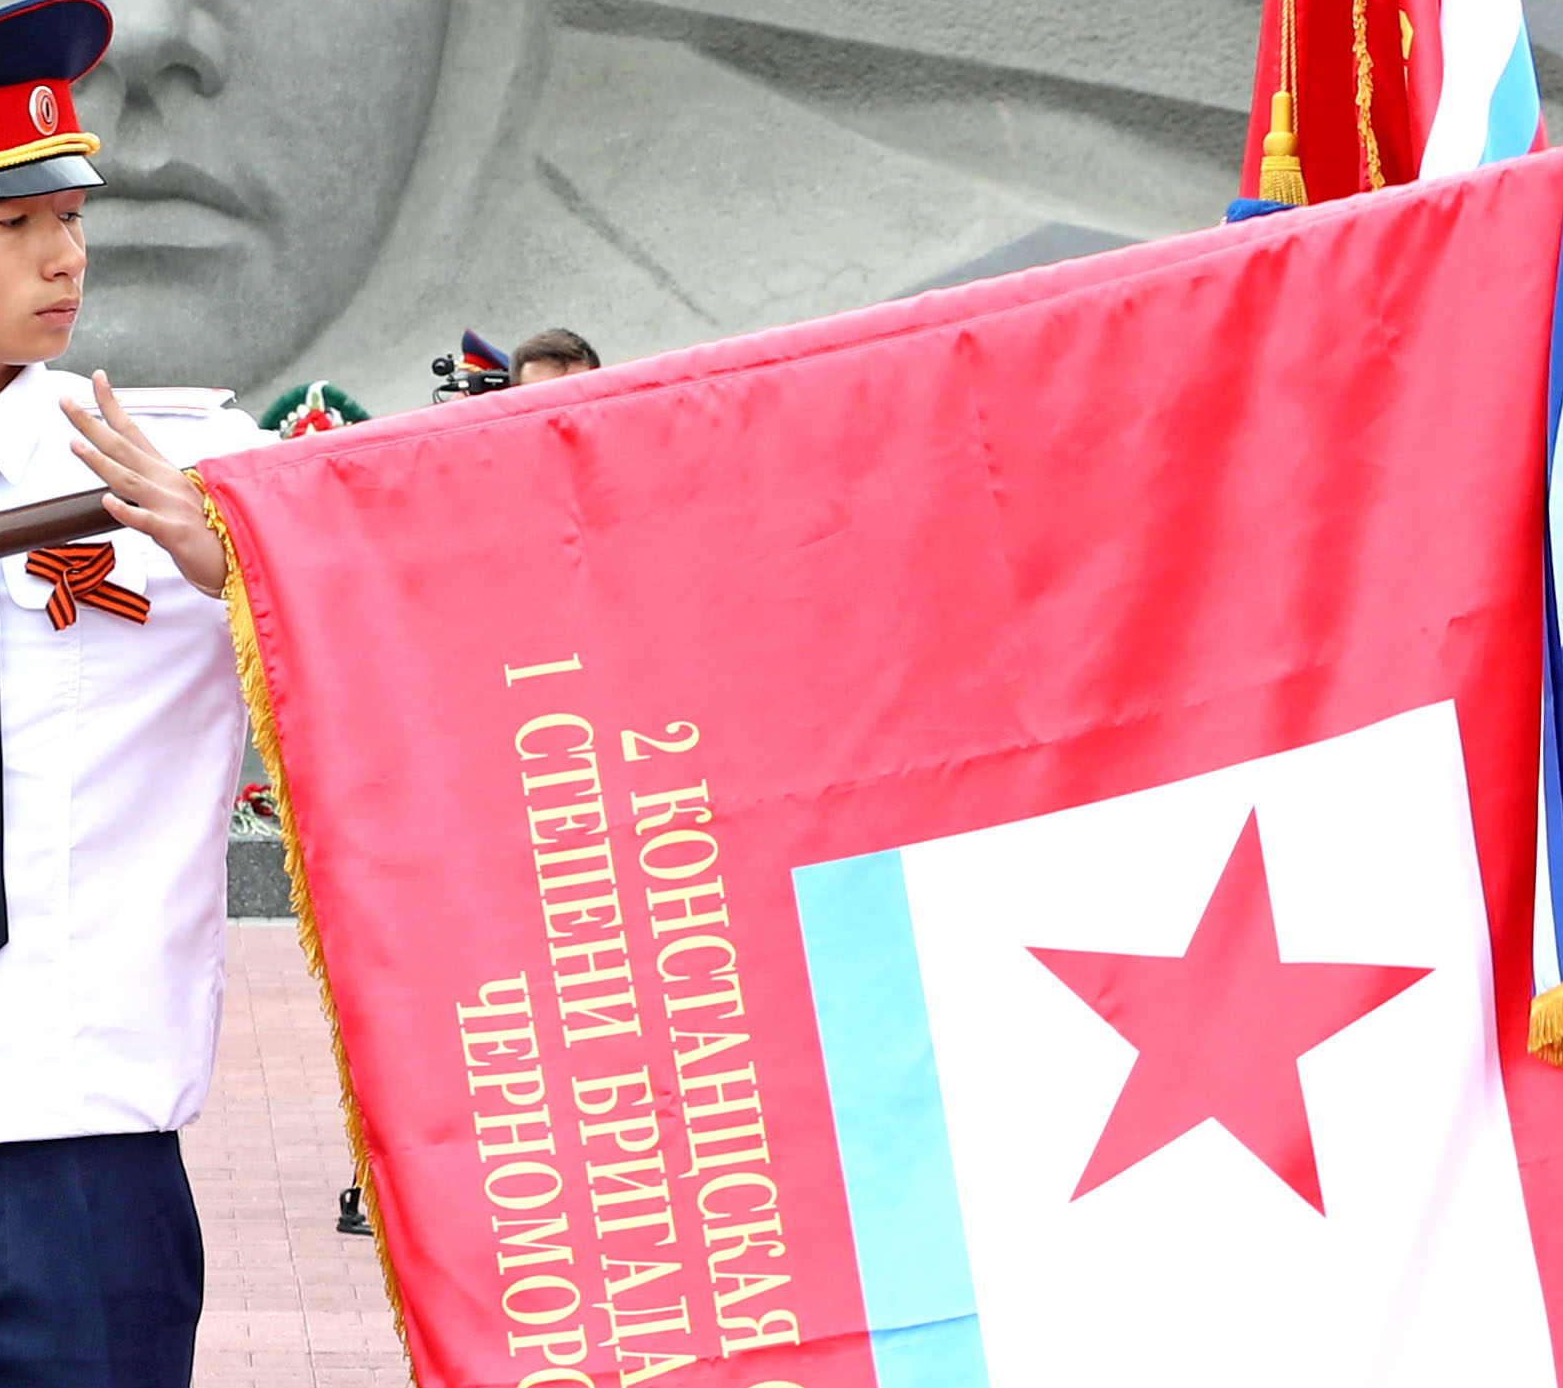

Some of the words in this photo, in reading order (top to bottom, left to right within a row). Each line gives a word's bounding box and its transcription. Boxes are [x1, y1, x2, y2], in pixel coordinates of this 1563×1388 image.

[504, 652, 583, 687] 1
[620, 721, 700, 762] 2
[515, 713, 642, 1048] СТЕПЕНИ
[630, 779, 801, 1358] КОНСТАНЦСКАЯ
